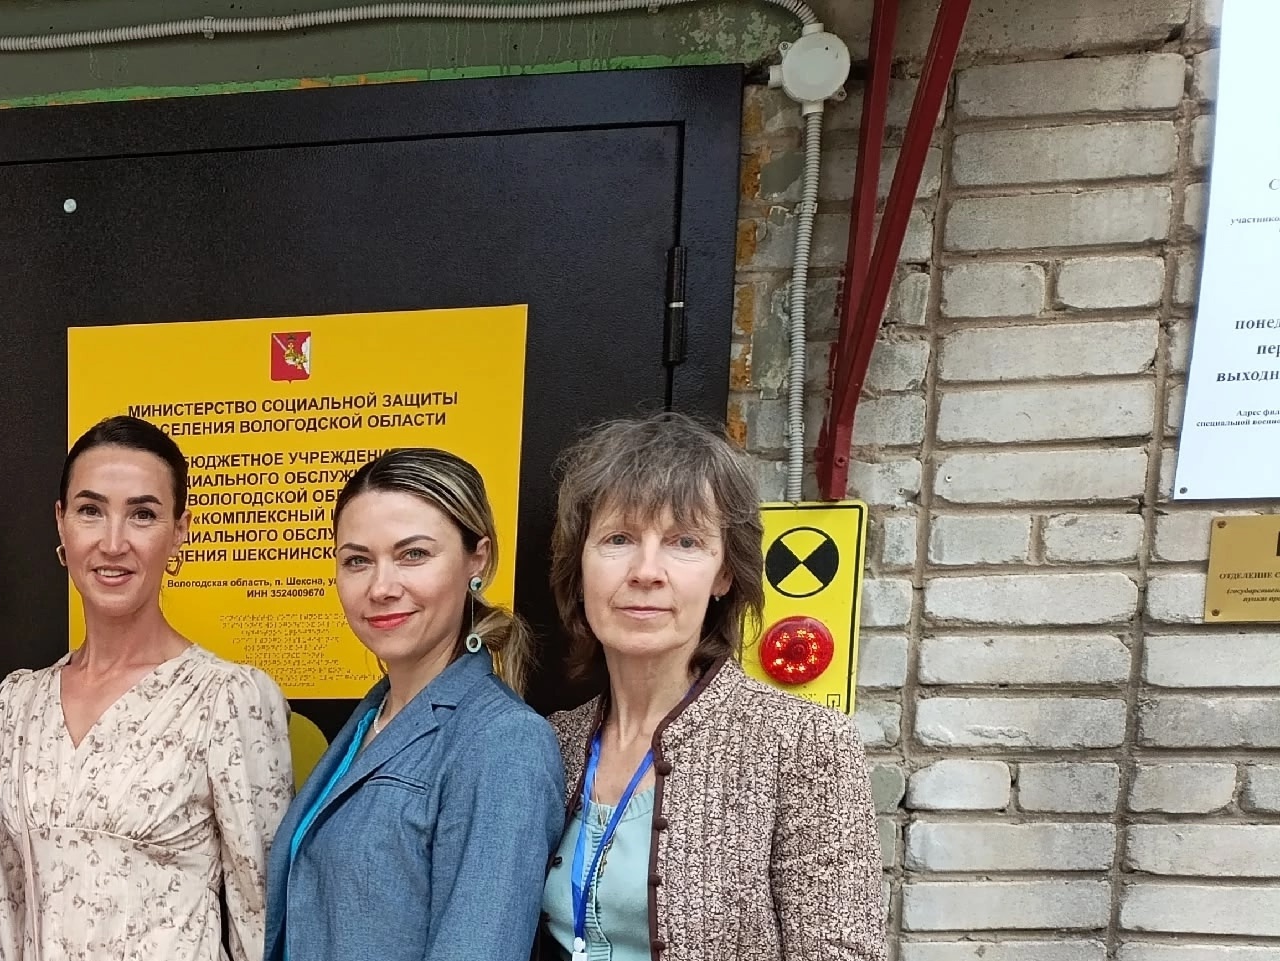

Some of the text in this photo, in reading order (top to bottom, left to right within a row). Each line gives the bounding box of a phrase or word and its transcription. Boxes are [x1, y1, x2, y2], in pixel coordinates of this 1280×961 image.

[128, 391, 458, 418] МИНИСТЕРСТВО СОЦИАЛЬНОЙ ЗАЩИТЫ
[156, 412, 446, 437] СЕЛЕНИЯ ВОЛОГОДСКОЙ ОБЛАСТИ
[284, 469, 358, 485] ОБСЛУЖ
[187, 487, 308, 507] ВОЛОГОДСКОЙ
[192, 506, 325, 525] «КОМПЛЕКСНЫЙ
[167, 579, 228, 589] Вологодская
[230, 578, 272, 588] область,
[274, 579, 283, 587] п.
[286, 576, 326, 587] Шексна,
[246, 588, 325, 599] ИНН 3524009670
